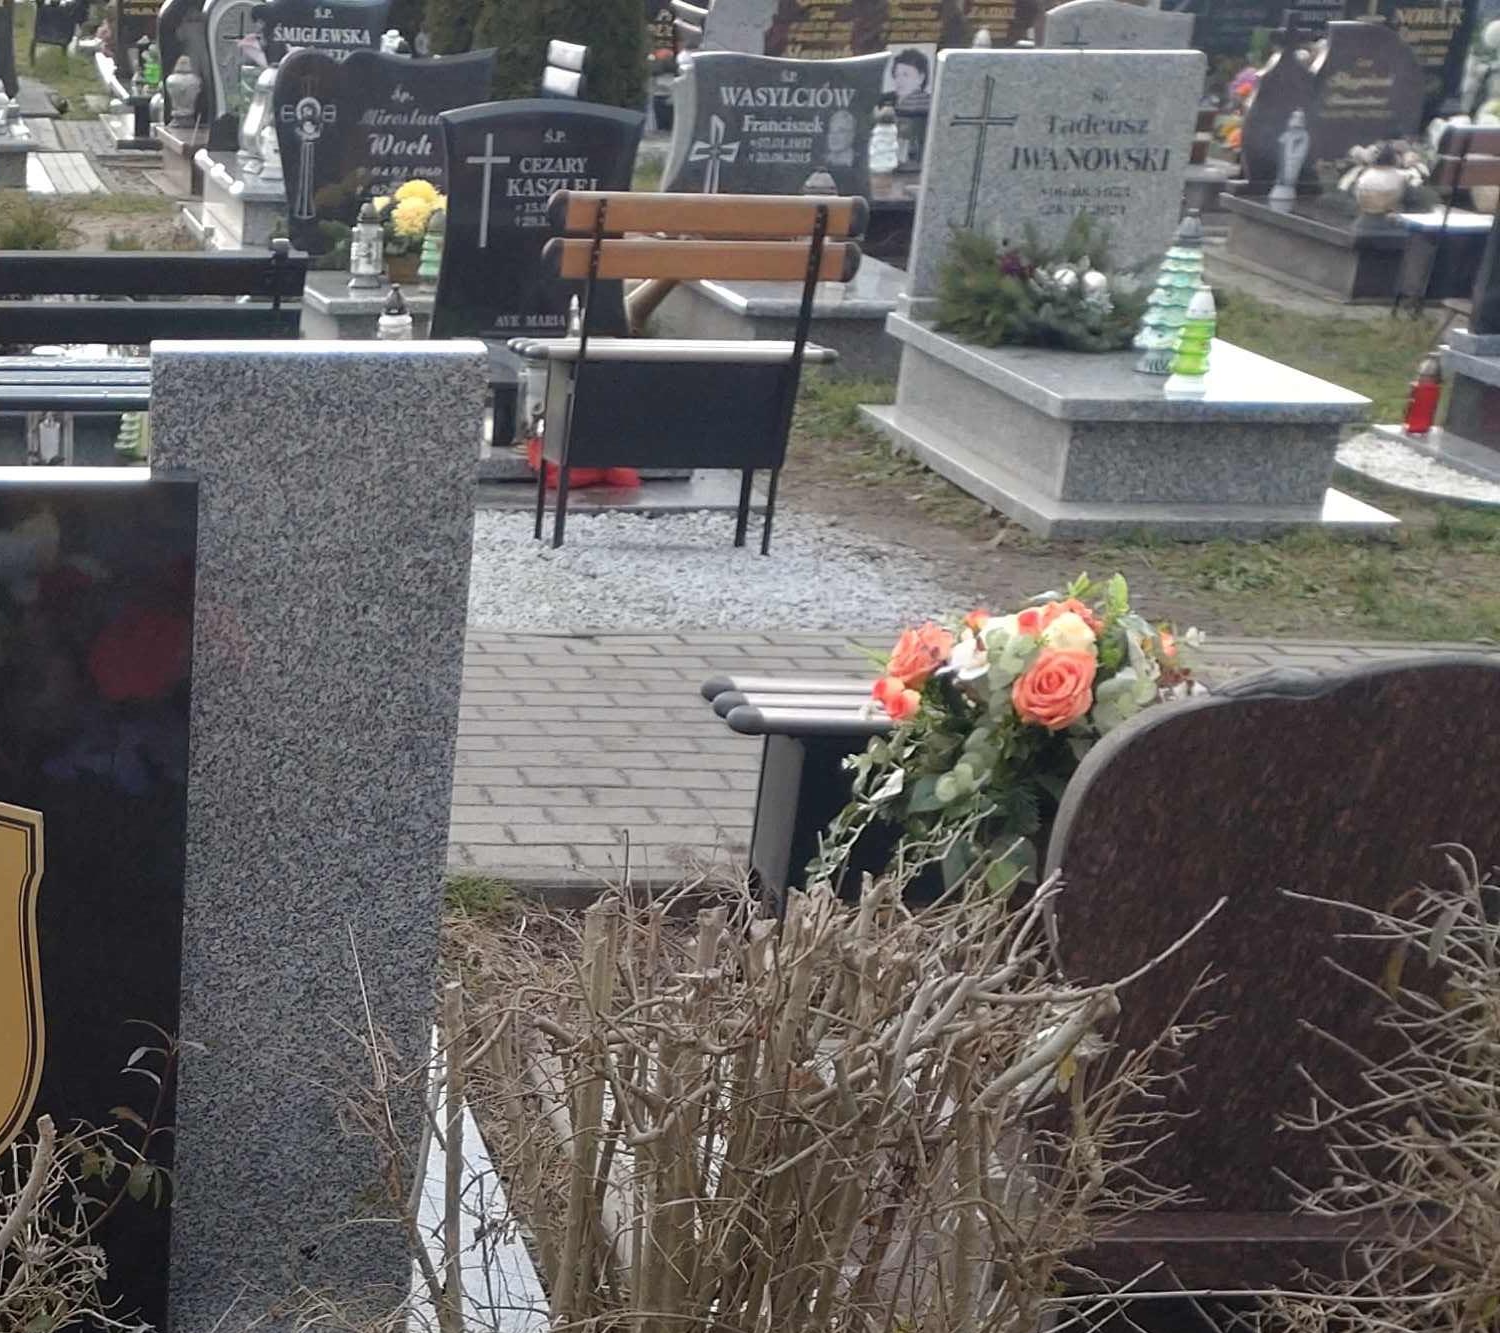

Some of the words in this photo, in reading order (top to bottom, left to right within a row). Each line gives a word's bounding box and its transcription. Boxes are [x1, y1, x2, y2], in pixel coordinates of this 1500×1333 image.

[273, 23, 372, 45] ŚMIGLEWSKA
[719, 82, 856, 108] WASYLCIÓW
[742, 114, 825, 134] Franciszek
[1047, 114, 1149, 136] Tadeusz
[519, 157, 588, 173] CEZARY
[1010, 146, 1171, 172] IWANOWSKI
